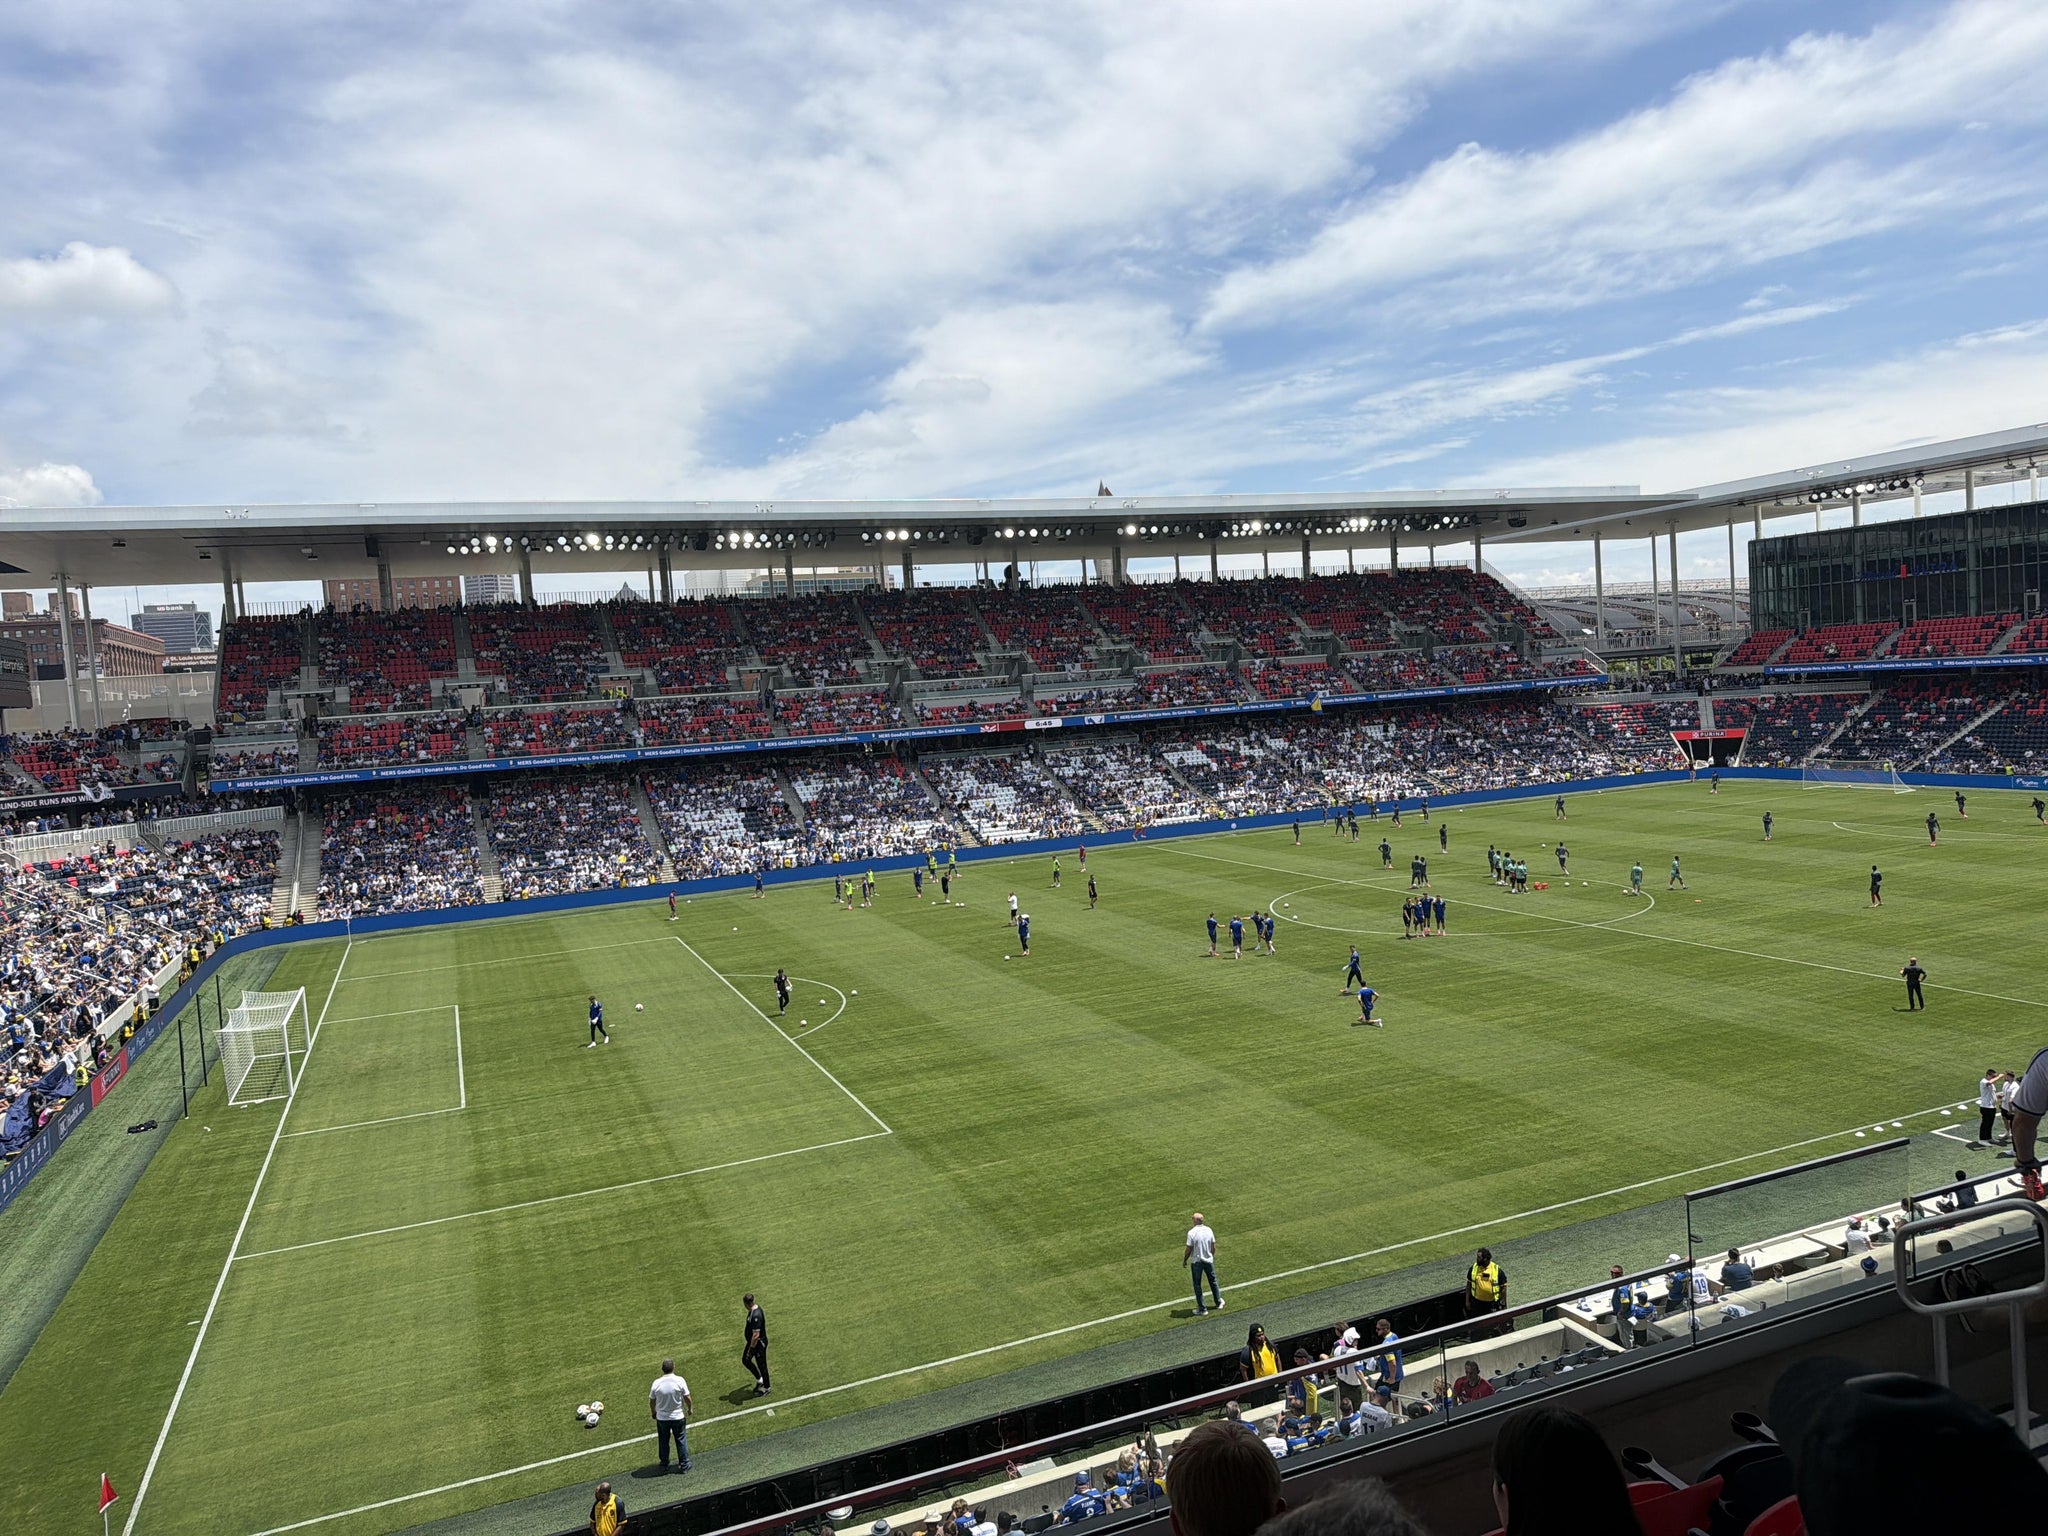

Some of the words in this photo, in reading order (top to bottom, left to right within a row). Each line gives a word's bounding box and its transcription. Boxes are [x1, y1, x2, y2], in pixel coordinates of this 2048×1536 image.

[0, 799, 37, 810] LIND-SIDE
[39, 798, 59, 806] RUNS
[1695, 1278, 1707, 1295] 19
